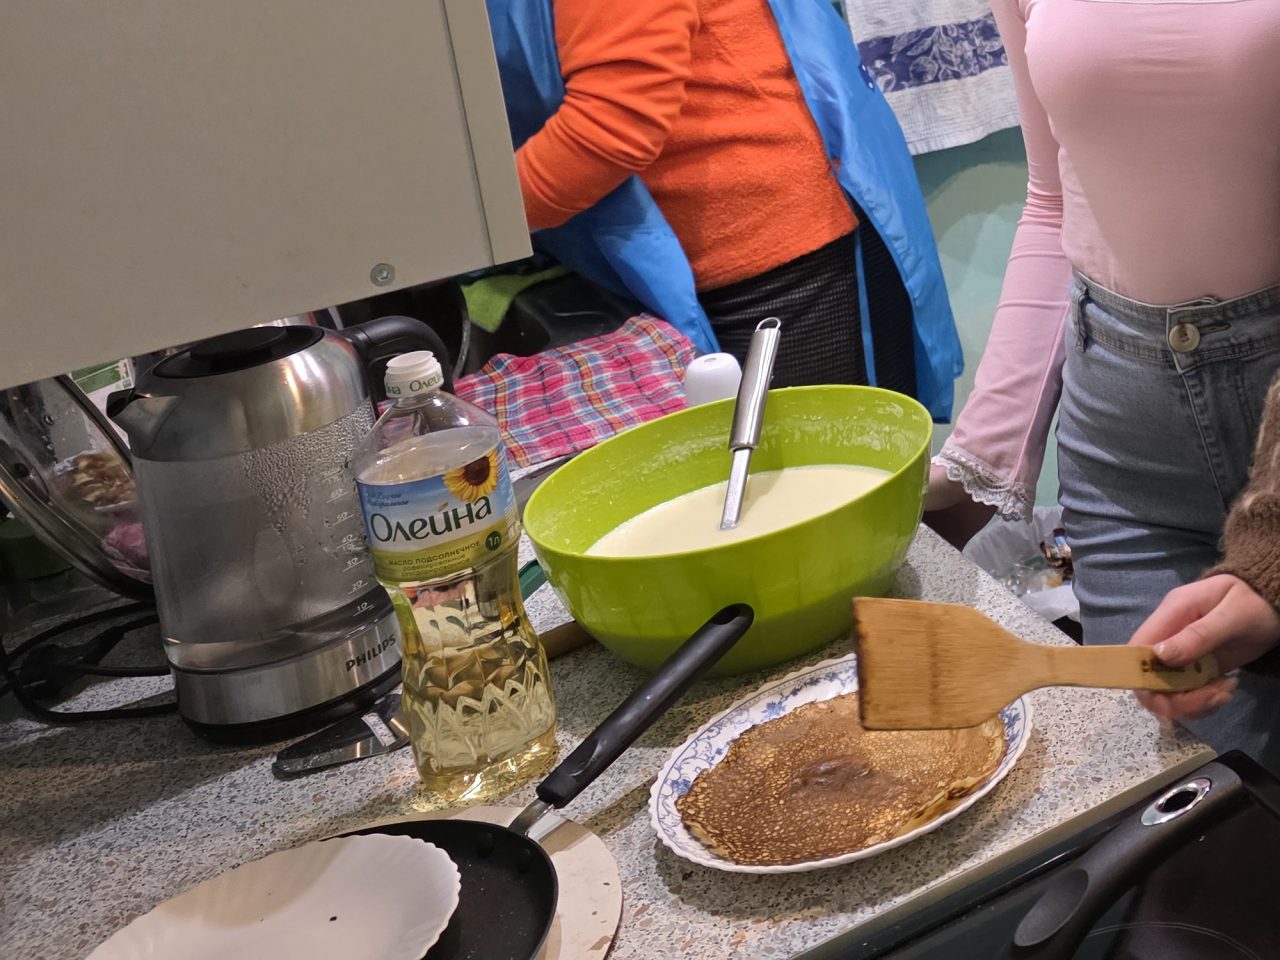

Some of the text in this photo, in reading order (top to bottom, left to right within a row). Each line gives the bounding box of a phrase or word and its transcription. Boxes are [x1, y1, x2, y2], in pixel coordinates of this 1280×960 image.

[370, 495, 492, 543] Олейна
[415, 540, 480, 565] ПОДСОЛНЕЧНОЕ
[345, 634, 397, 673] PHILIPS
